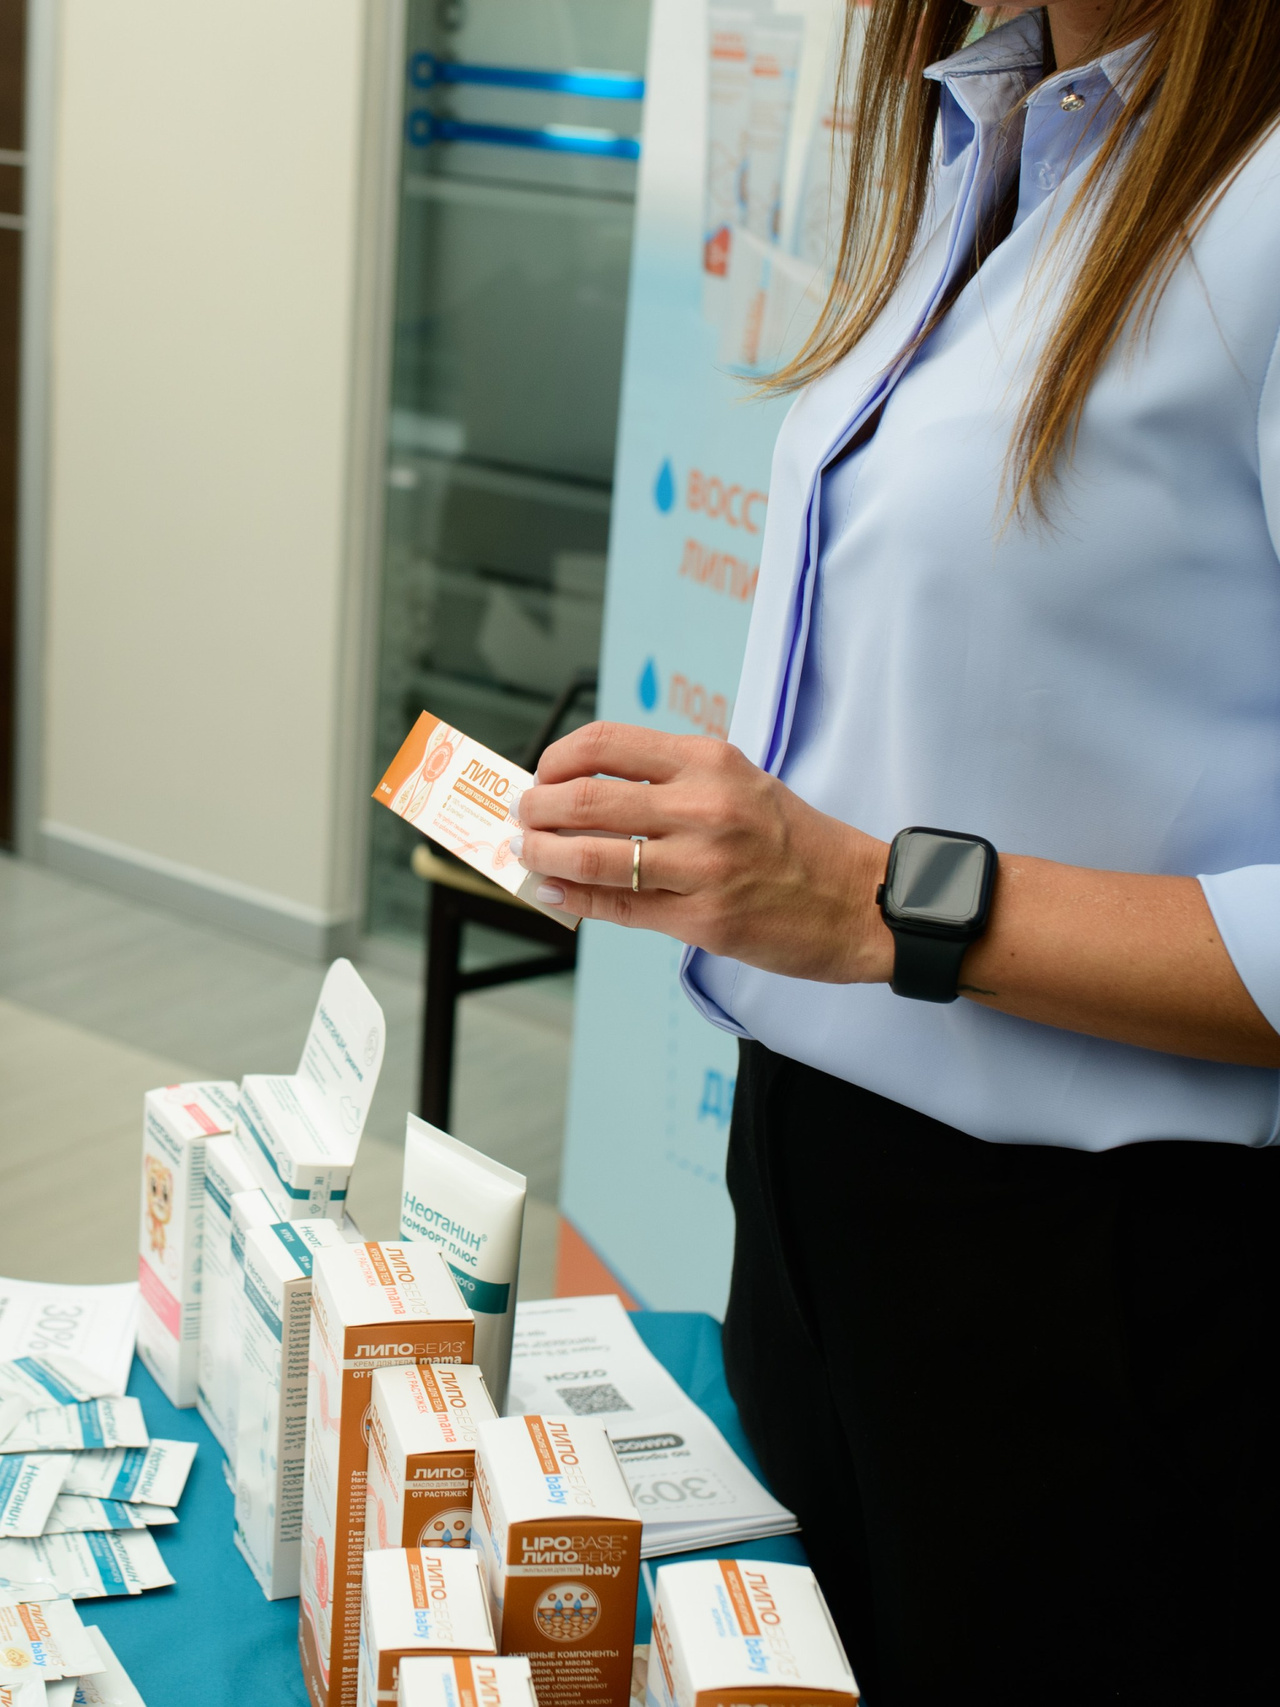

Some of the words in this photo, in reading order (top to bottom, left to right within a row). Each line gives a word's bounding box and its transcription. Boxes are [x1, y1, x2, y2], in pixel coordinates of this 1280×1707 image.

[685, 468, 768, 535] ВОСС
[668, 673, 730, 743] ПОД
[461, 758, 521, 804] ЛИПОБ
[300, 1225, 323, 1248] Неот
[401, 1214, 448, 1248] КОМФОРТ
[448, 1242, 478, 1267] ПЛЮС
[354, 1248, 363, 1258] ОТ
[369, 1247, 381, 1262] КРЕМ
[357, 1256, 378, 1287] РАСТЯЖЕК
[374, 1261, 387, 1273] ДЛЯ
[379, 1272, 392, 1285] ТЕЛА
[384, 1287, 406, 1315] mama
[353, 1360, 375, 1368] КРЕМ
[420, 1354, 462, 1365] mama
[352, 1370, 365, 1379] ОТ
[404, 1370, 415, 1380] ОТ
[406, 1381, 429, 1414] РАСТЯЖЕК
[436, 1413, 457, 1443] mama
[413, 1467, 474, 1479] ЛИПОБ
[5, 1464, 41, 1531] Неотанин
[424, 1490, 468, 1498] РАСТЯЖЕК
[546, 1476, 568, 1506] baby
[585, 1562, 621, 1578] baby
[413, 1610, 431, 1639] baby
[30, 1641, 47, 1667] baby
[557, 1650, 619, 1659] КОМПОНЕНТЫ
[745, 1638, 770, 1674] baby
